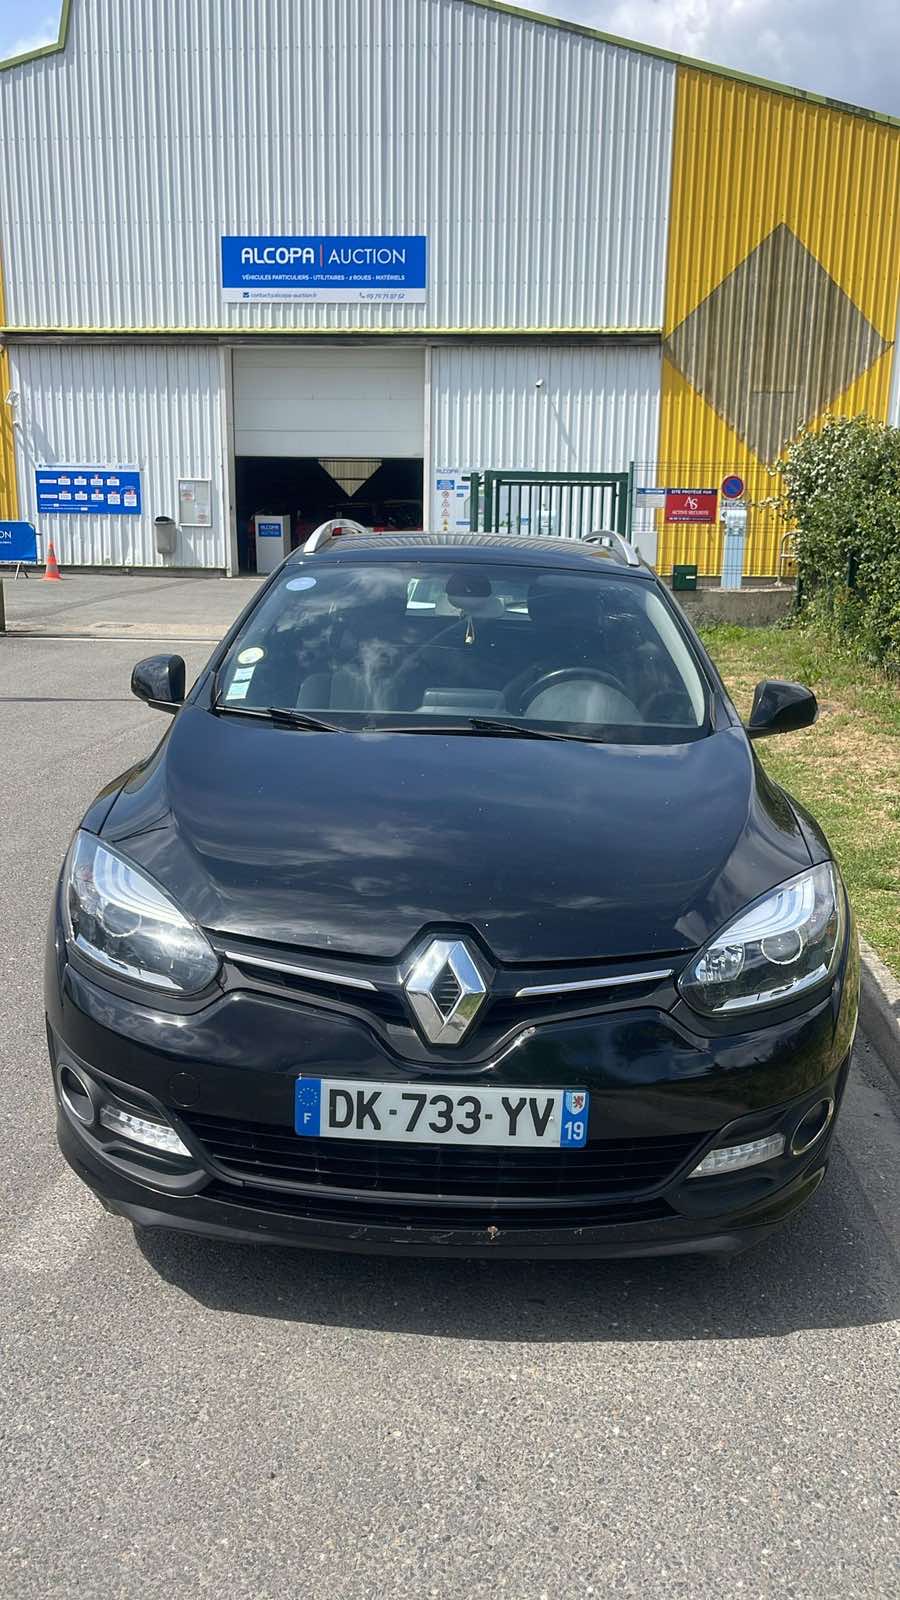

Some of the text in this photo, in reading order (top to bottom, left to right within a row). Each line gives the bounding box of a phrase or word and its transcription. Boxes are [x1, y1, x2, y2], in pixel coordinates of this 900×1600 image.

[241, 247, 406, 264] ALCOPA AUCTION
[272, 273, 309, 281] PARTICULIERS
[312, 273, 345, 281] UTILITAIRES
[353, 273, 372, 281] ROUES
[684, 496, 698, 510] AS
[303, 1112, 312, 1125] F
[328, 1088, 556, 1138] DK-733-YV
[564, 1120, 585, 1141] 19
